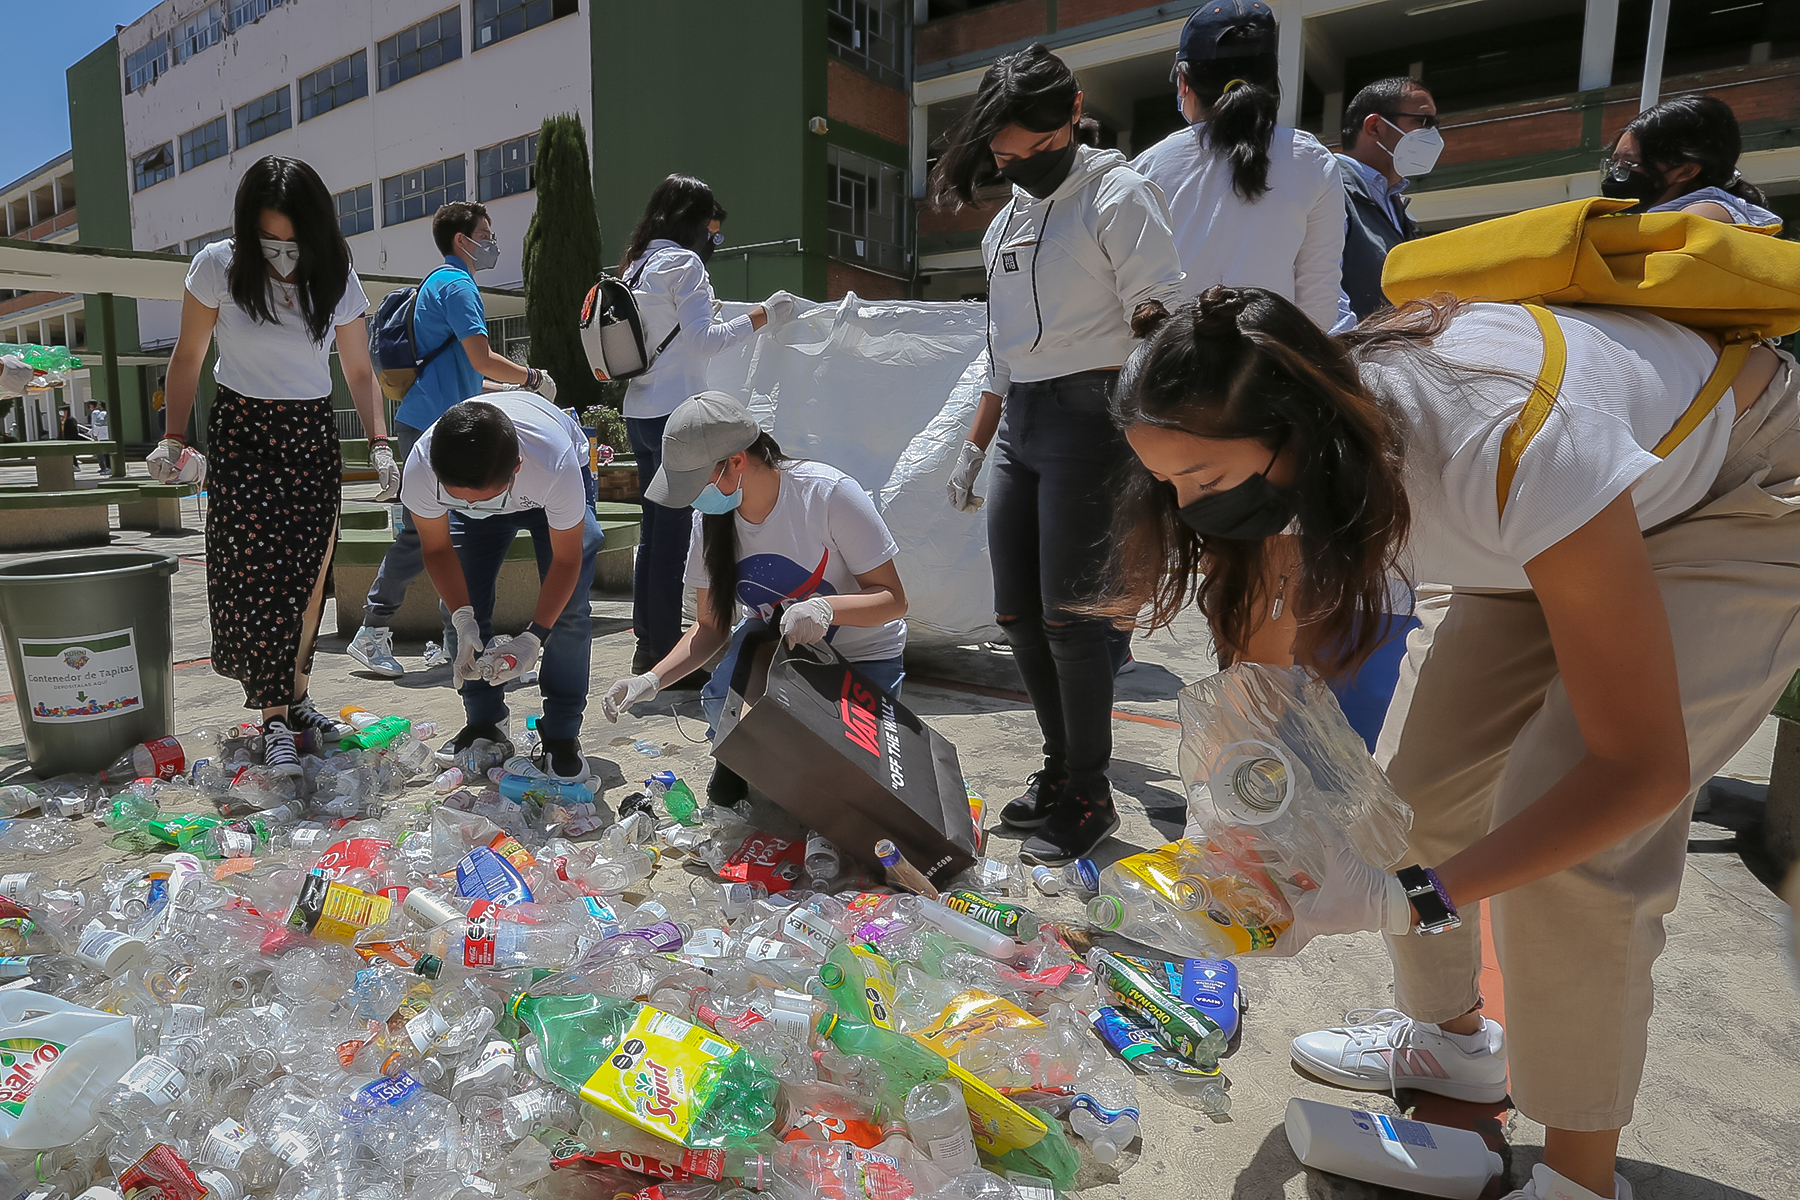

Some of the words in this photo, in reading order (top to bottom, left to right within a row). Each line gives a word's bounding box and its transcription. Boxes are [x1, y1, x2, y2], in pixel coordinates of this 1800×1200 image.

[28, 672, 82, 683] Contenedor
[84, 670, 97, 680] de
[99, 664, 135, 678] Tapitas
[841, 671, 881, 758] VANS
[885, 731, 902, 759] THE
[1128, 988, 1171, 1024] ORIGINAL
[1195, 996, 1223, 1006] NIVEA
[645, 1057, 679, 1126] Squirt
